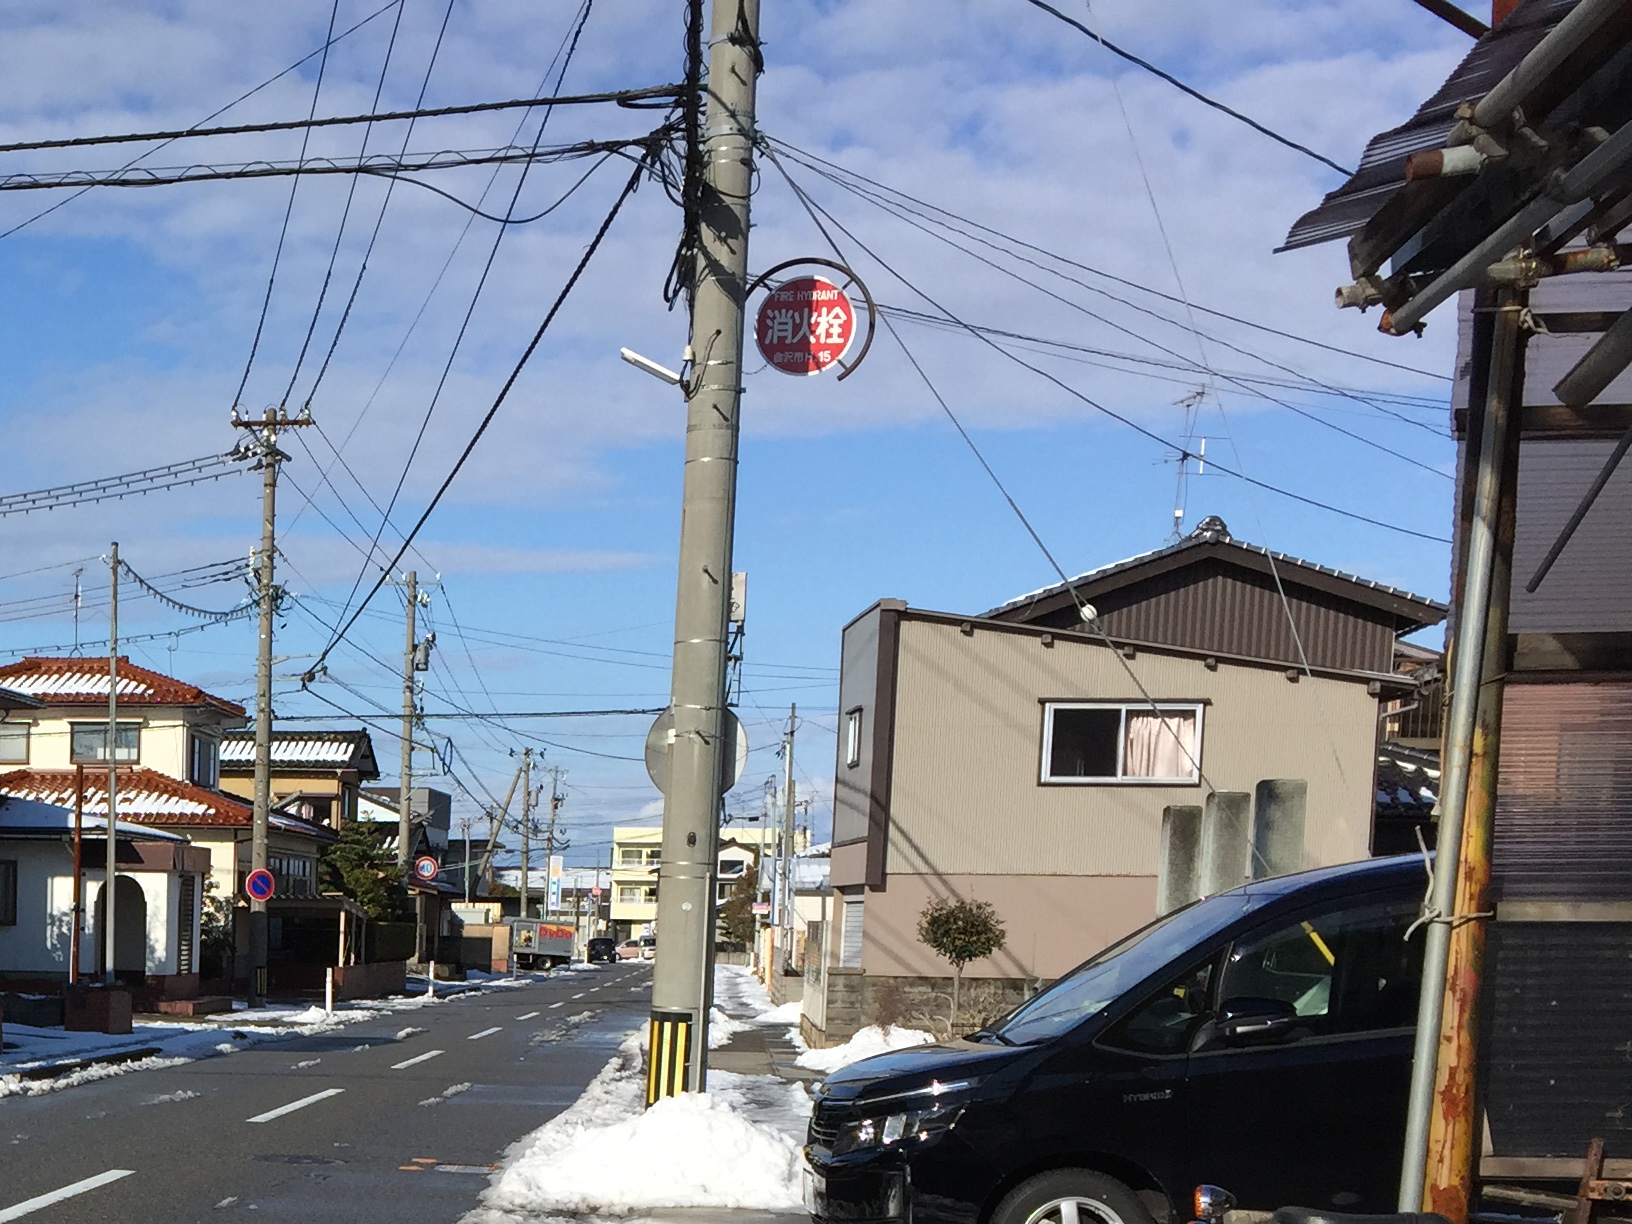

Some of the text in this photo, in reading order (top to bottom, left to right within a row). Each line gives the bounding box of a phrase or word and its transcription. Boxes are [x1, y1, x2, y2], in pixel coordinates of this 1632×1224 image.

[774, 290, 839, 302] FIRE HYDRANT
[764, 306, 847, 345] 消火栓
[419, 863, 433, 873] 40
[539, 926, 573, 940] DyDo
